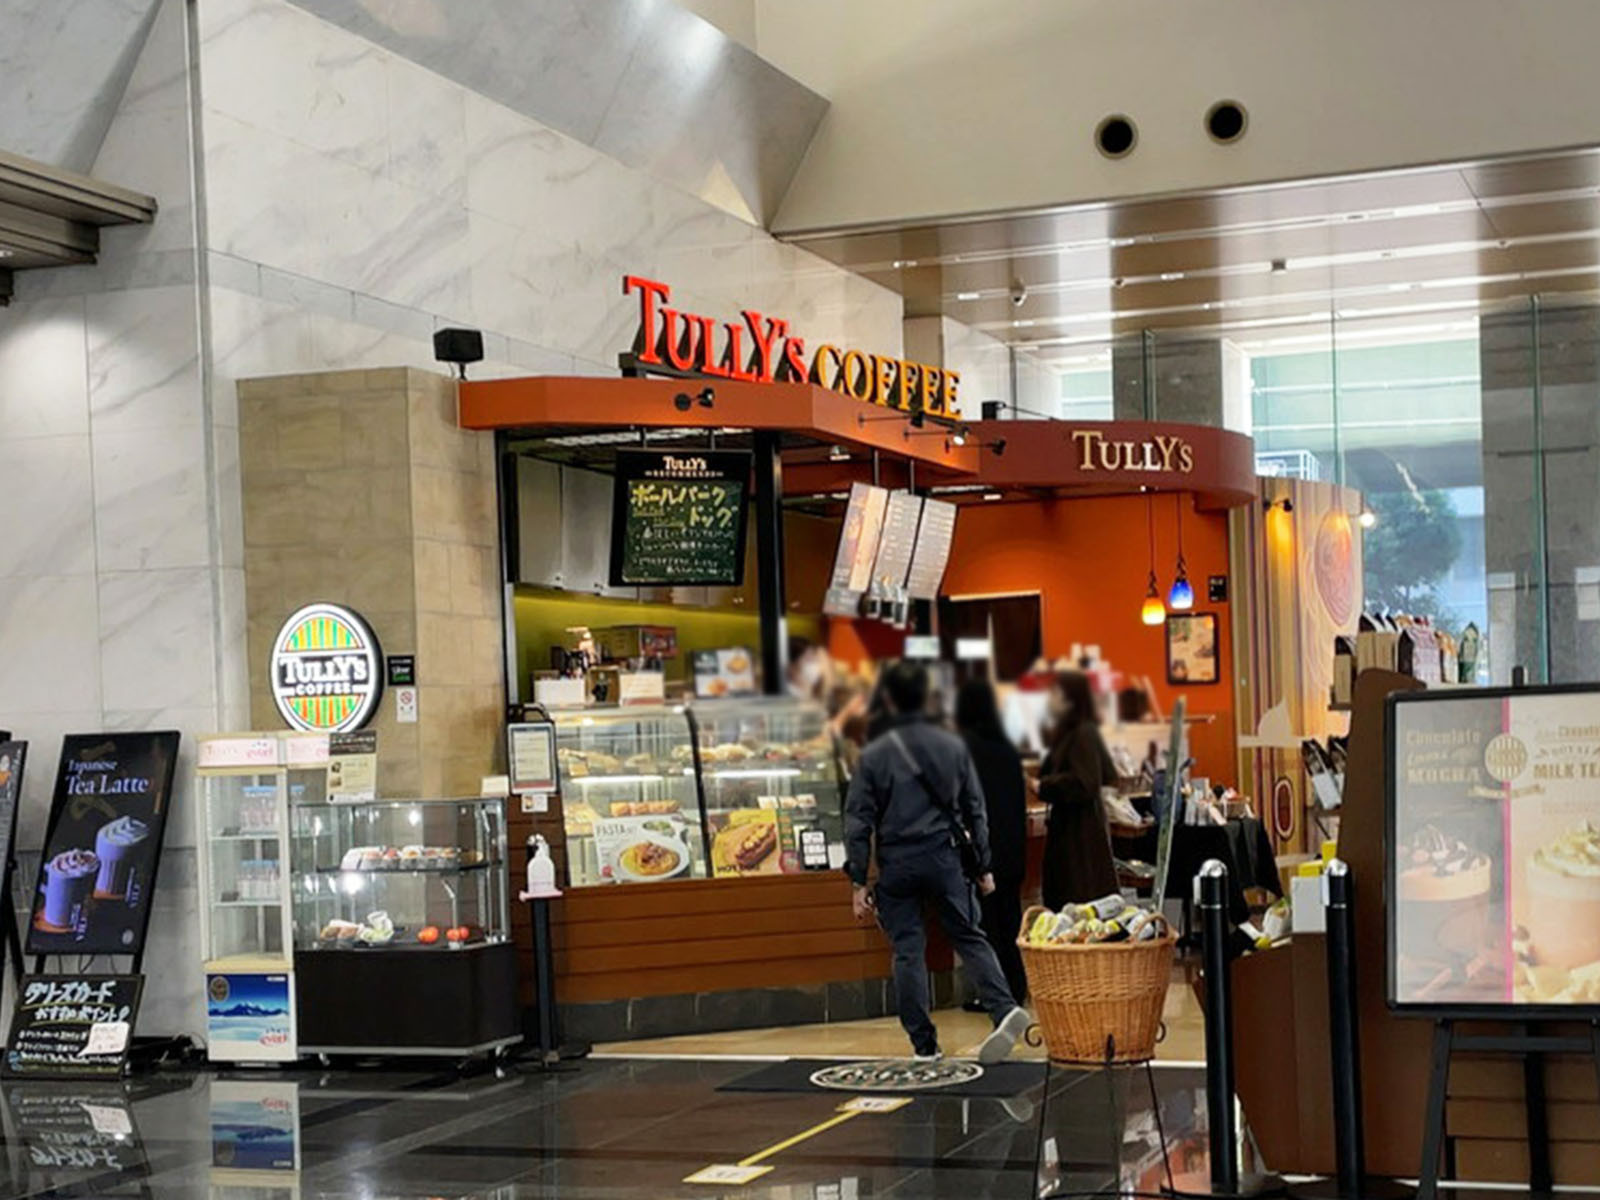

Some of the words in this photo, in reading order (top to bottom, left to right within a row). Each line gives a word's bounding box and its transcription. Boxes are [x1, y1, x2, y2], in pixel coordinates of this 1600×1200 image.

[816, 344, 962, 419] COFFEE
[1071, 430, 1193, 473] TULLY'S
[279, 656, 367, 684] TULLY'S
[295, 683, 351, 696] COFFEE
[1533, 763, 1574, 778] MILK
[65, 774, 96, 795] Tea
[99, 774, 149, 794] Latte
